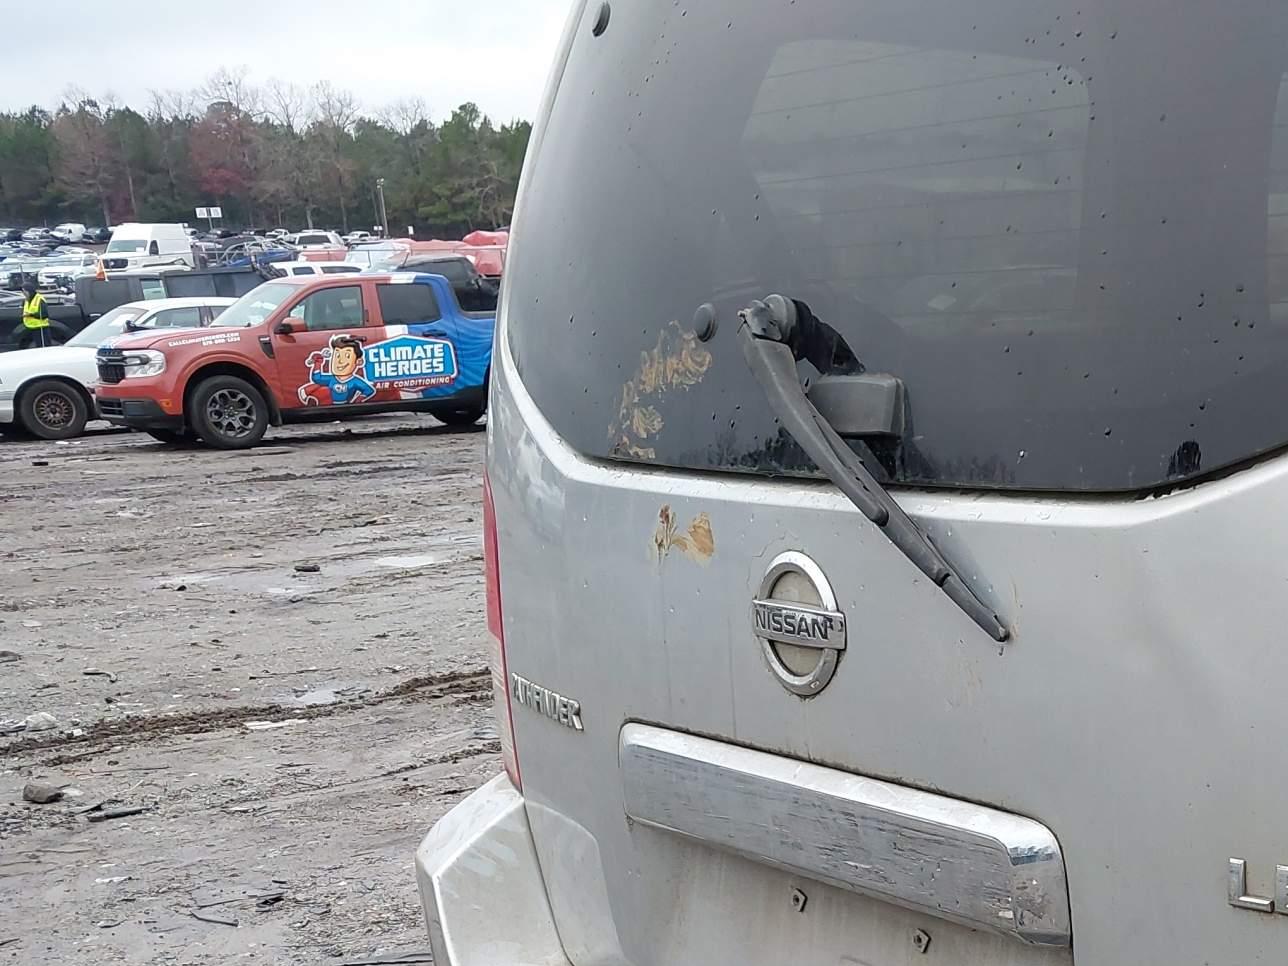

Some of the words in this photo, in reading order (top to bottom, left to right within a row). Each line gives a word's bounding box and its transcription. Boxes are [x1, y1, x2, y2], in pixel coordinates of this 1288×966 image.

[369, 343, 445, 363] CLIMATE
[374, 358, 445, 378] HEROES
[375, 381, 391, 390] AIR
[393, 376, 451, 388] CONDITIONING
[755, 607, 830, 641] NISSAN
